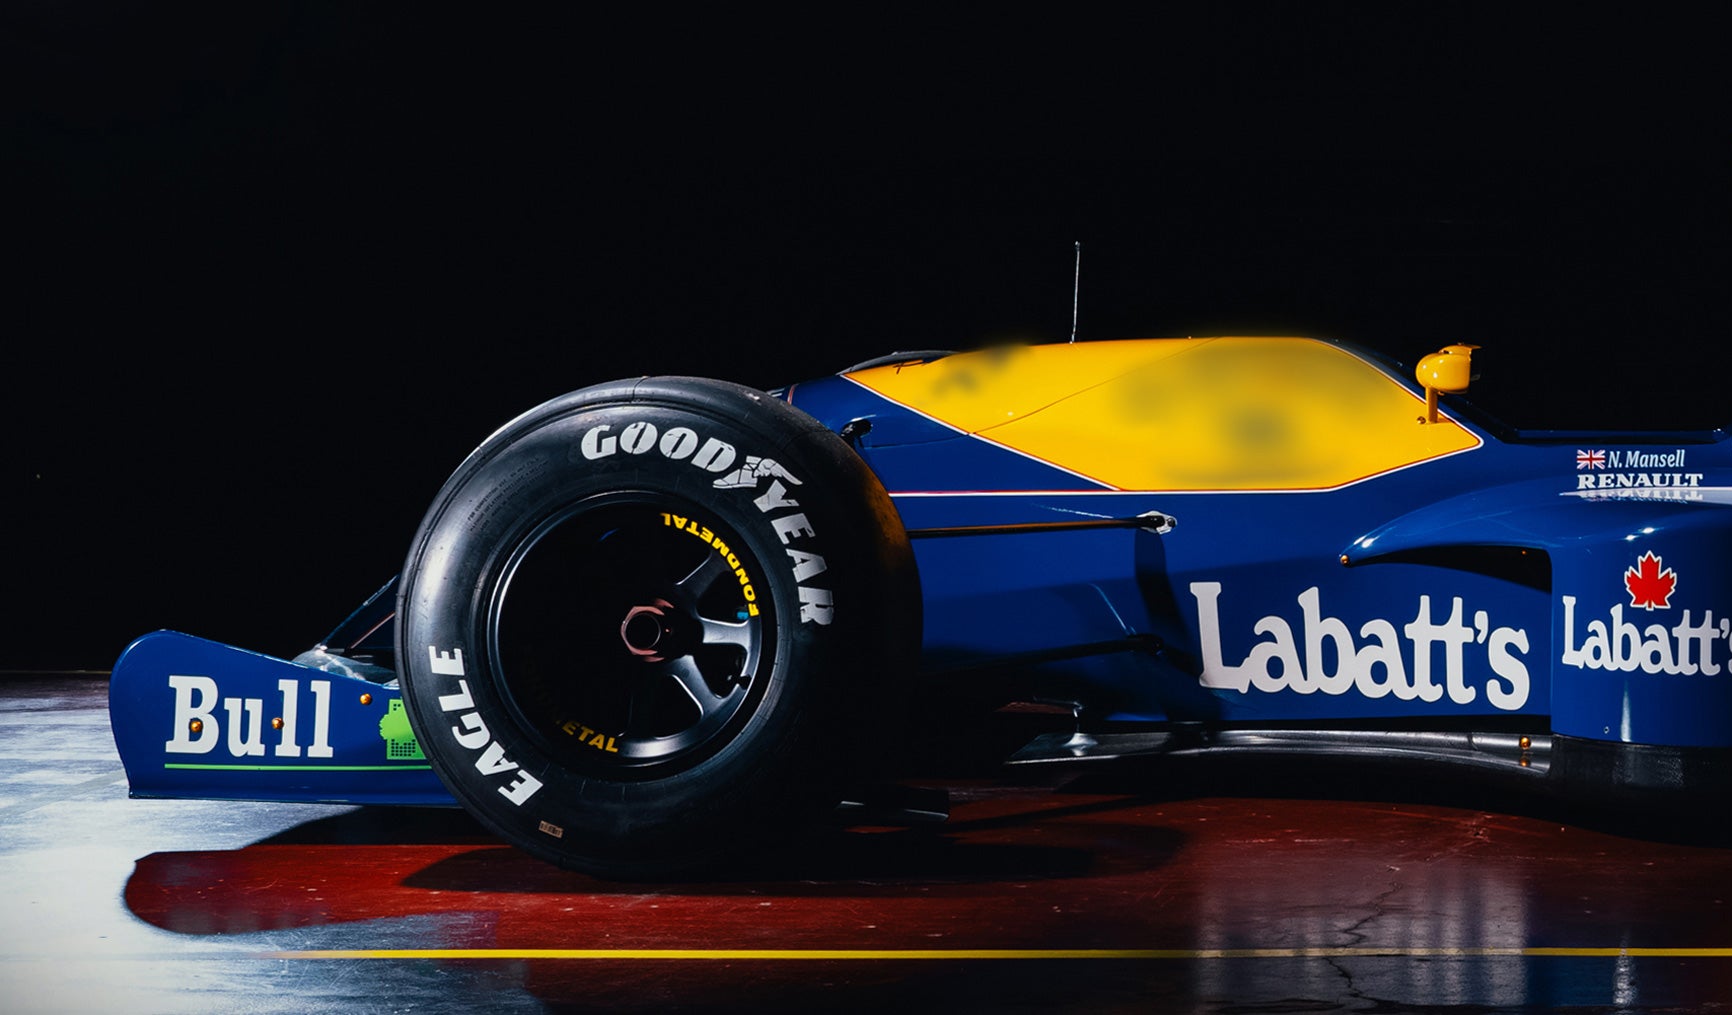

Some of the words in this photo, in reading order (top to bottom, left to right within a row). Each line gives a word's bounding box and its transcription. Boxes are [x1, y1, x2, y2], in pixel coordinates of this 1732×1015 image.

[1576, 472, 1704, 490] RENAULT
[1607, 450, 1623, 469] N.
[1624, 449, 1686, 468] Mansell
[581, 421, 835, 626] GOODYEAR
[660, 513, 760, 617] FONDMETAL
[1189, 581, 1531, 711] Labatt's
[165, 675, 335, 759] Bull
[428, 644, 544, 807] EAGLE
